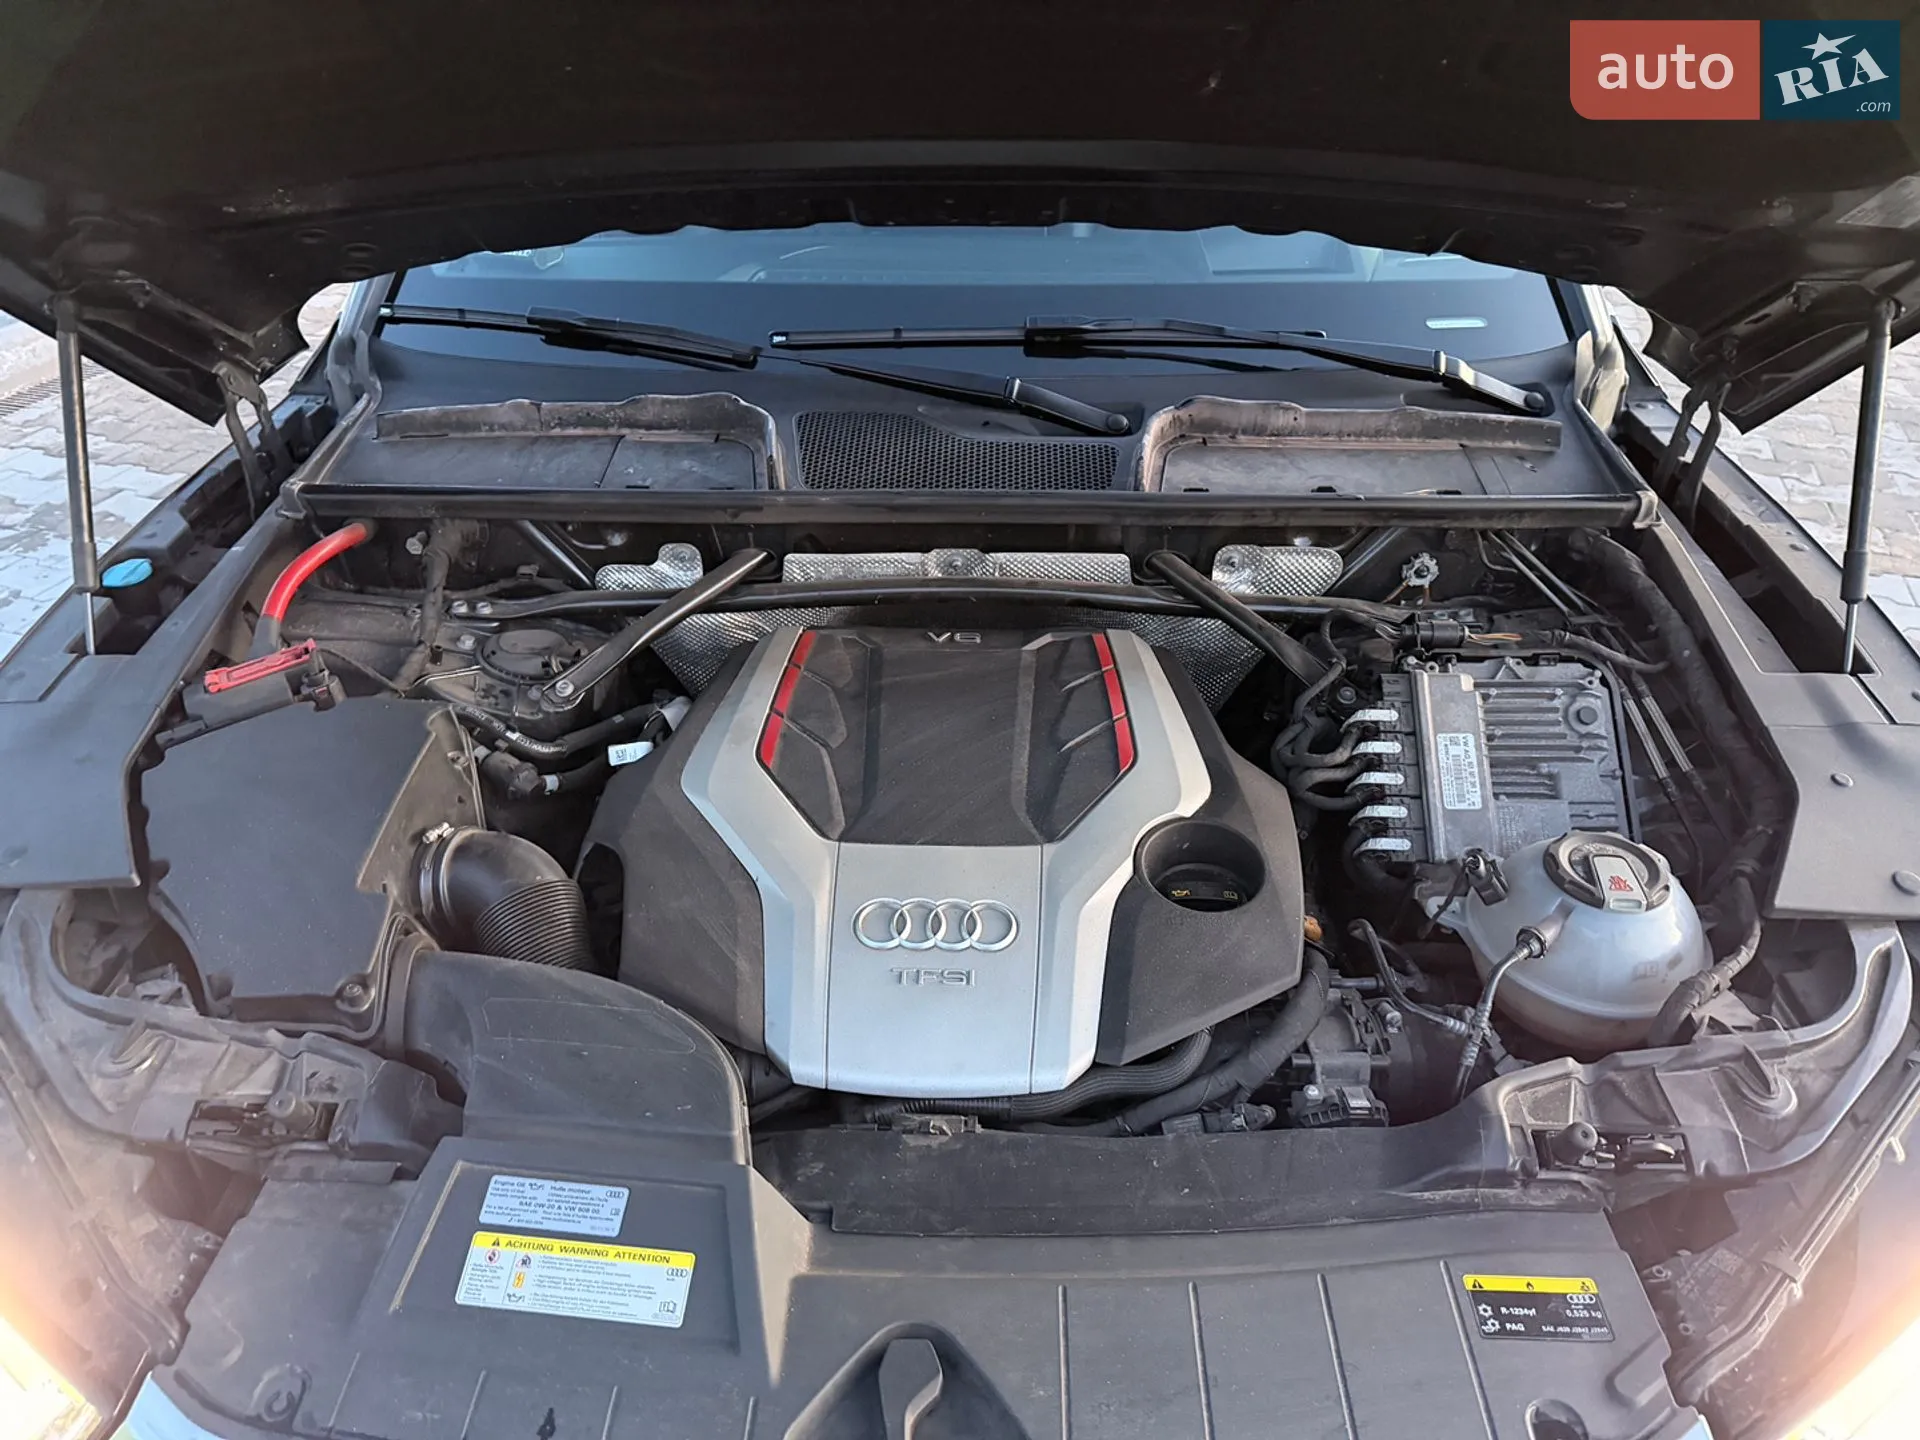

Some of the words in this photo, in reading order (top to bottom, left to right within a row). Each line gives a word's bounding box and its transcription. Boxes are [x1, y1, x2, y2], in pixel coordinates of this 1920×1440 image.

[927, 631, 982, 644] V6
[890, 967, 976, 987] TFSI
[505, 1239, 554, 1252] ACHTUNG
[559, 1245, 609, 1258] WARNING
[613, 1250, 671, 1264] ATTENTION
[1500, 1306, 1536, 1317] R-1234yf
[1591, 1309, 1602, 1319] kg
